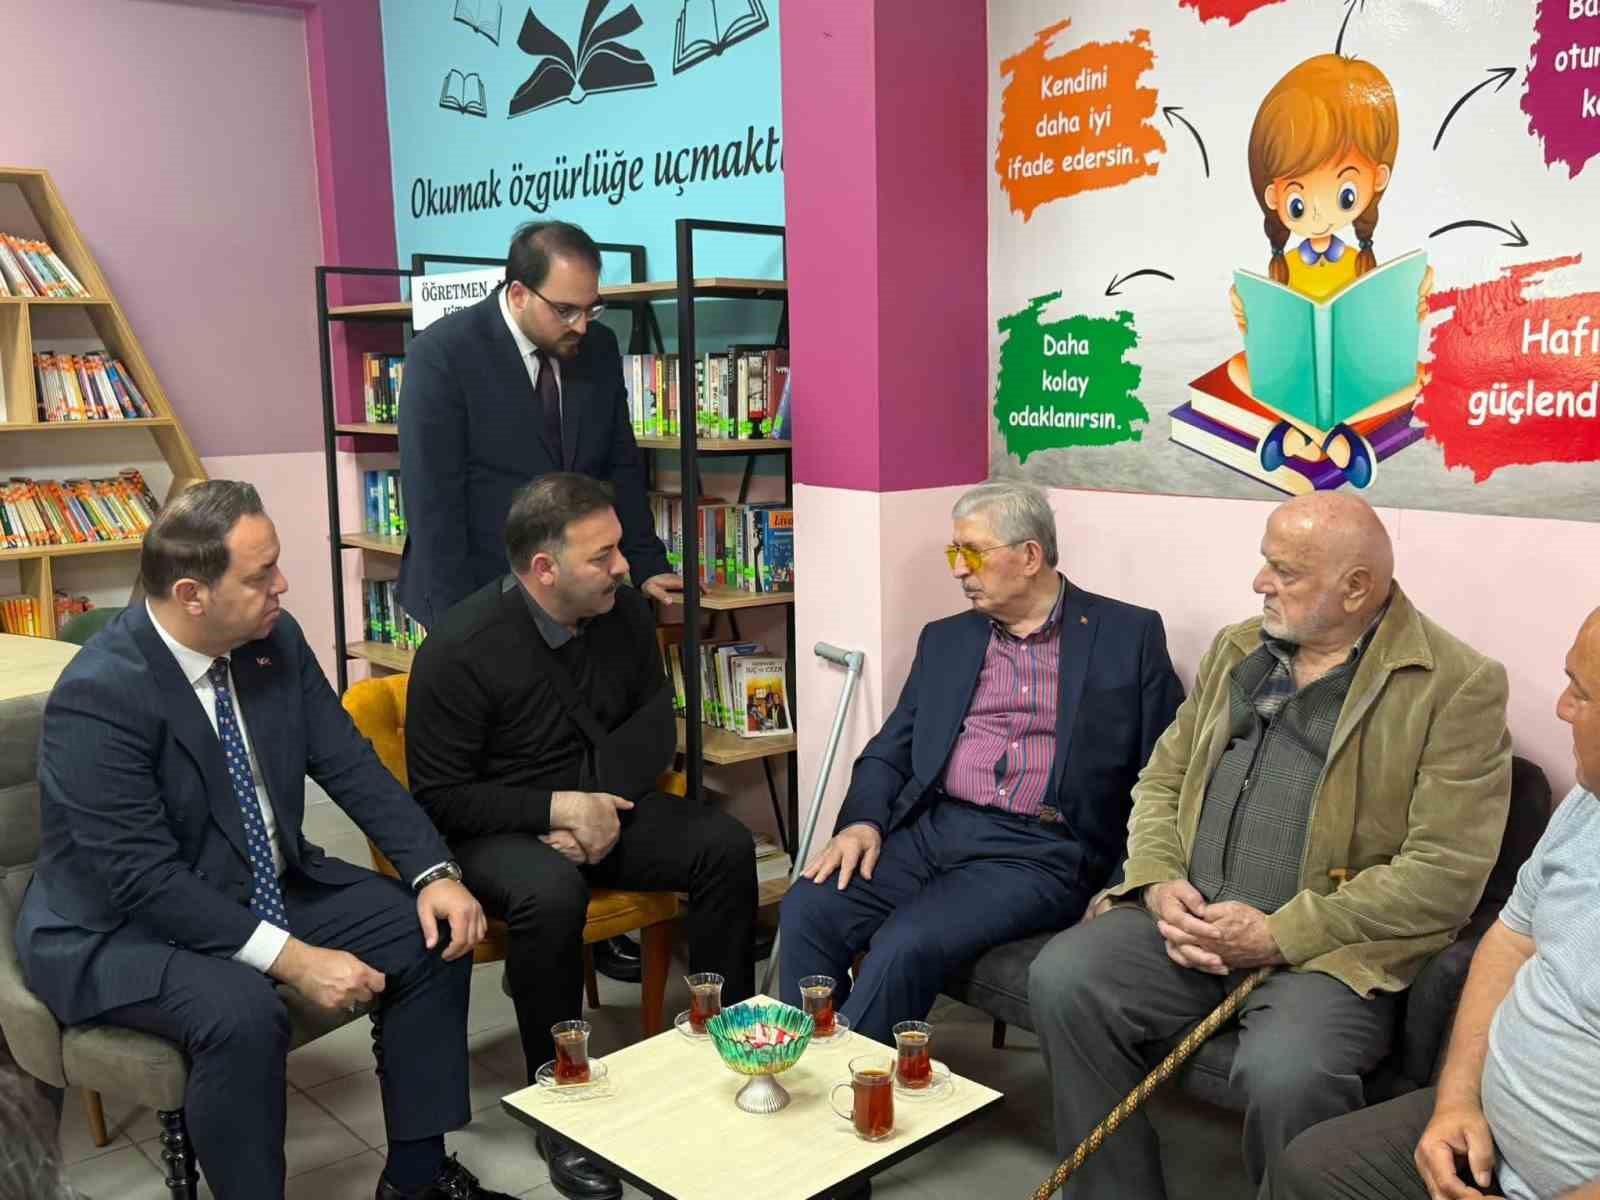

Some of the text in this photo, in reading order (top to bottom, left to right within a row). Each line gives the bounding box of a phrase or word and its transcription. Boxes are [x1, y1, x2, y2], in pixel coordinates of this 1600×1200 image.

[1041, 66, 1108, 99] Kendini
[1035, 104, 1112, 138] daha iyi
[1007, 143, 1140, 180] ifade edersin.
[410, 168, 502, 219] Okumak
[508, 150, 644, 214] özgürlüğe
[421, 281, 488, 302] ÖĞRETMEN
[1043, 333, 1090, 356] Daha
[1041, 369, 1090, 398] kolay
[1008, 405, 1122, 430] odaklanırsın.
[1467, 379, 1599, 426] güçlend
